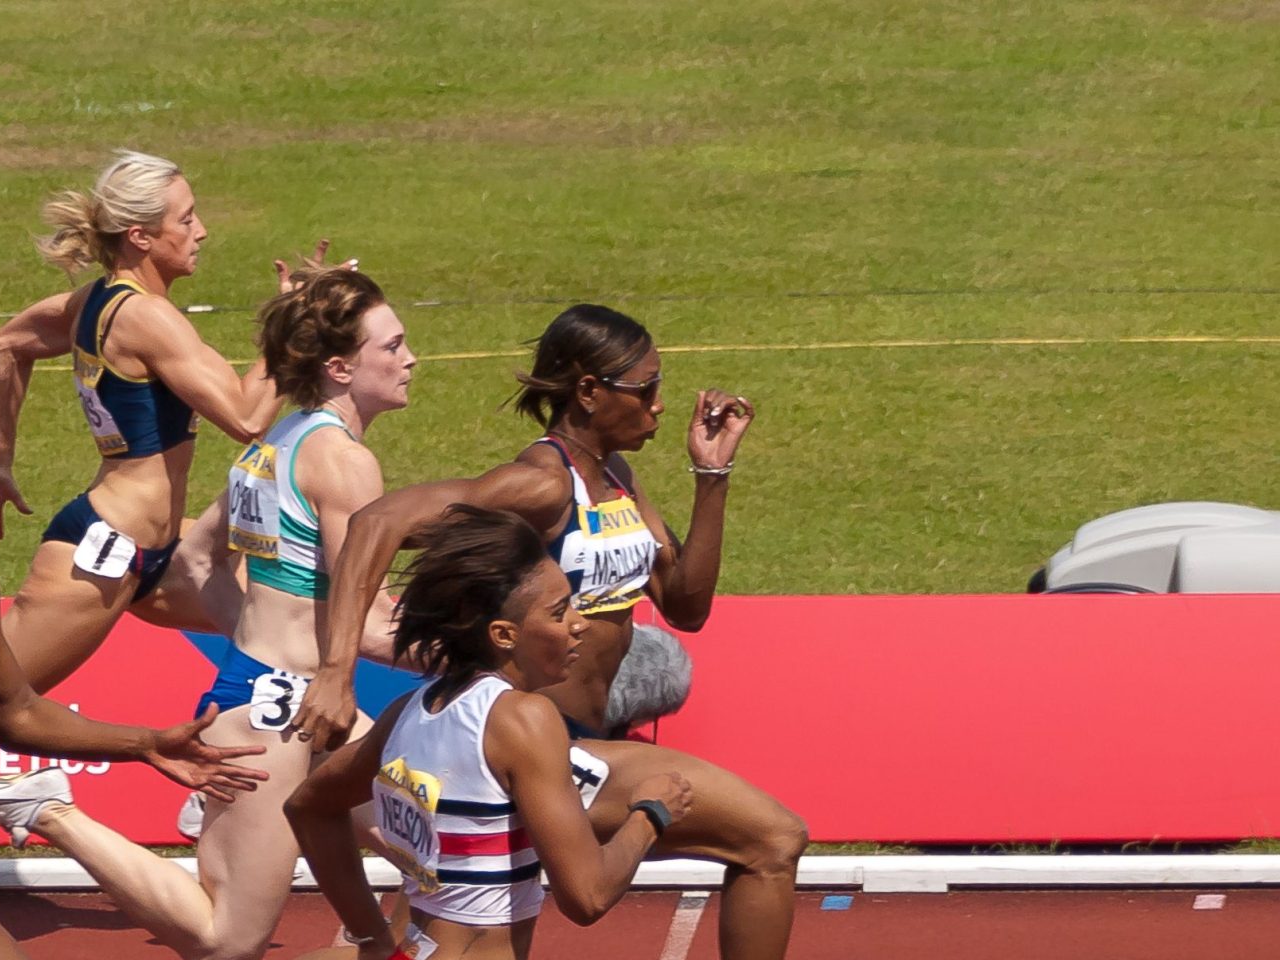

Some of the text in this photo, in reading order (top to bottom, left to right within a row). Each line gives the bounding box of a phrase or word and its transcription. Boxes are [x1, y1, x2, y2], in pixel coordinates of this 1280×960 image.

[92, 531, 119, 570] 1
[261, 678, 294, 727] 3
[380, 793, 433, 857] NELSON
